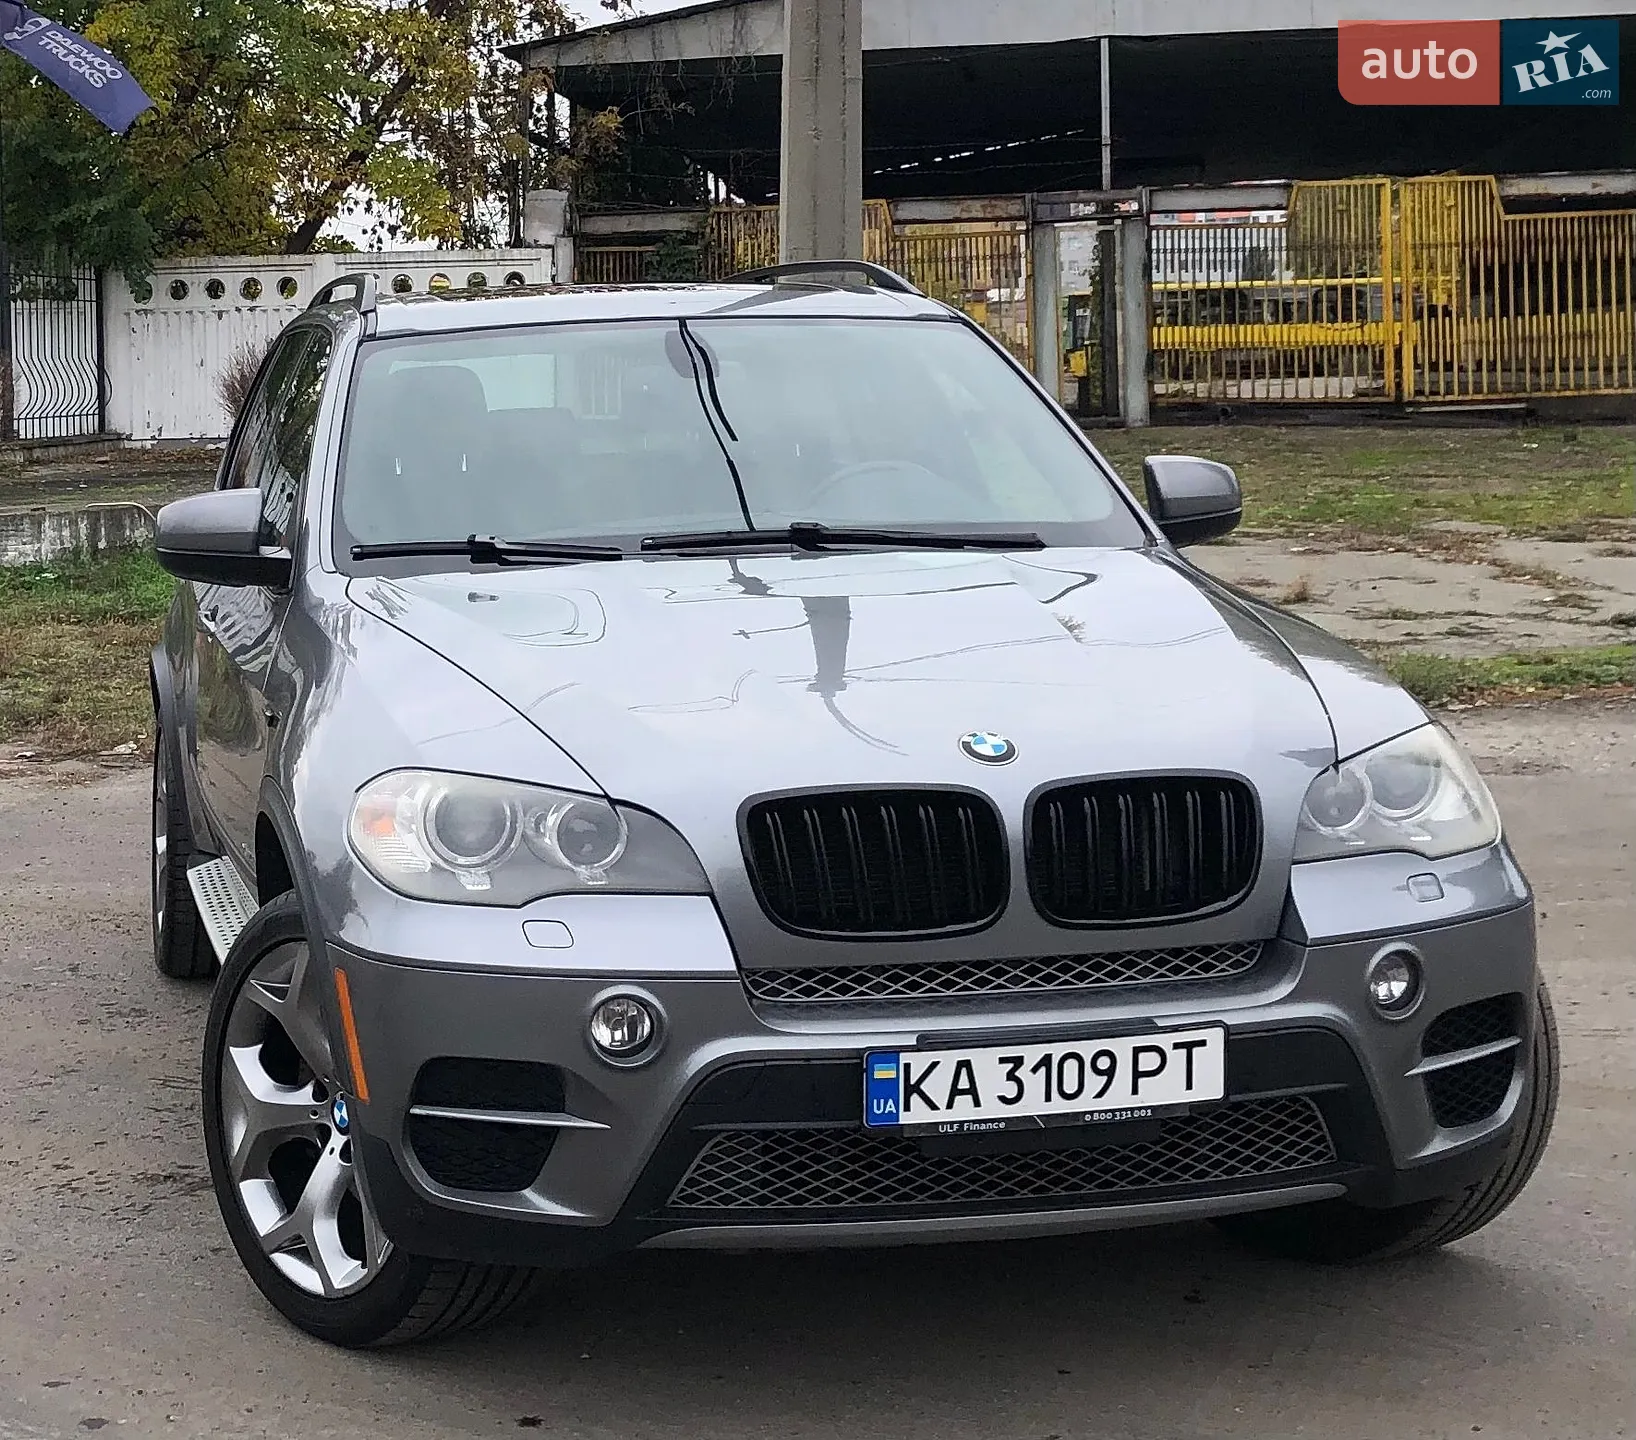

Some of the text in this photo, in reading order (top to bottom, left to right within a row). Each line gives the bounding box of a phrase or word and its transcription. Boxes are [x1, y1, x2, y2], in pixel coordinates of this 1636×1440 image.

[38, 35, 107, 89] TRUCKS
[46, 30, 123, 80] DAEWOO
[902, 1039, 1208, 1112] KA 3109 PT
[873, 1097, 897, 1114] UA
[938, 1120, 1006, 1133] ULF Finance
